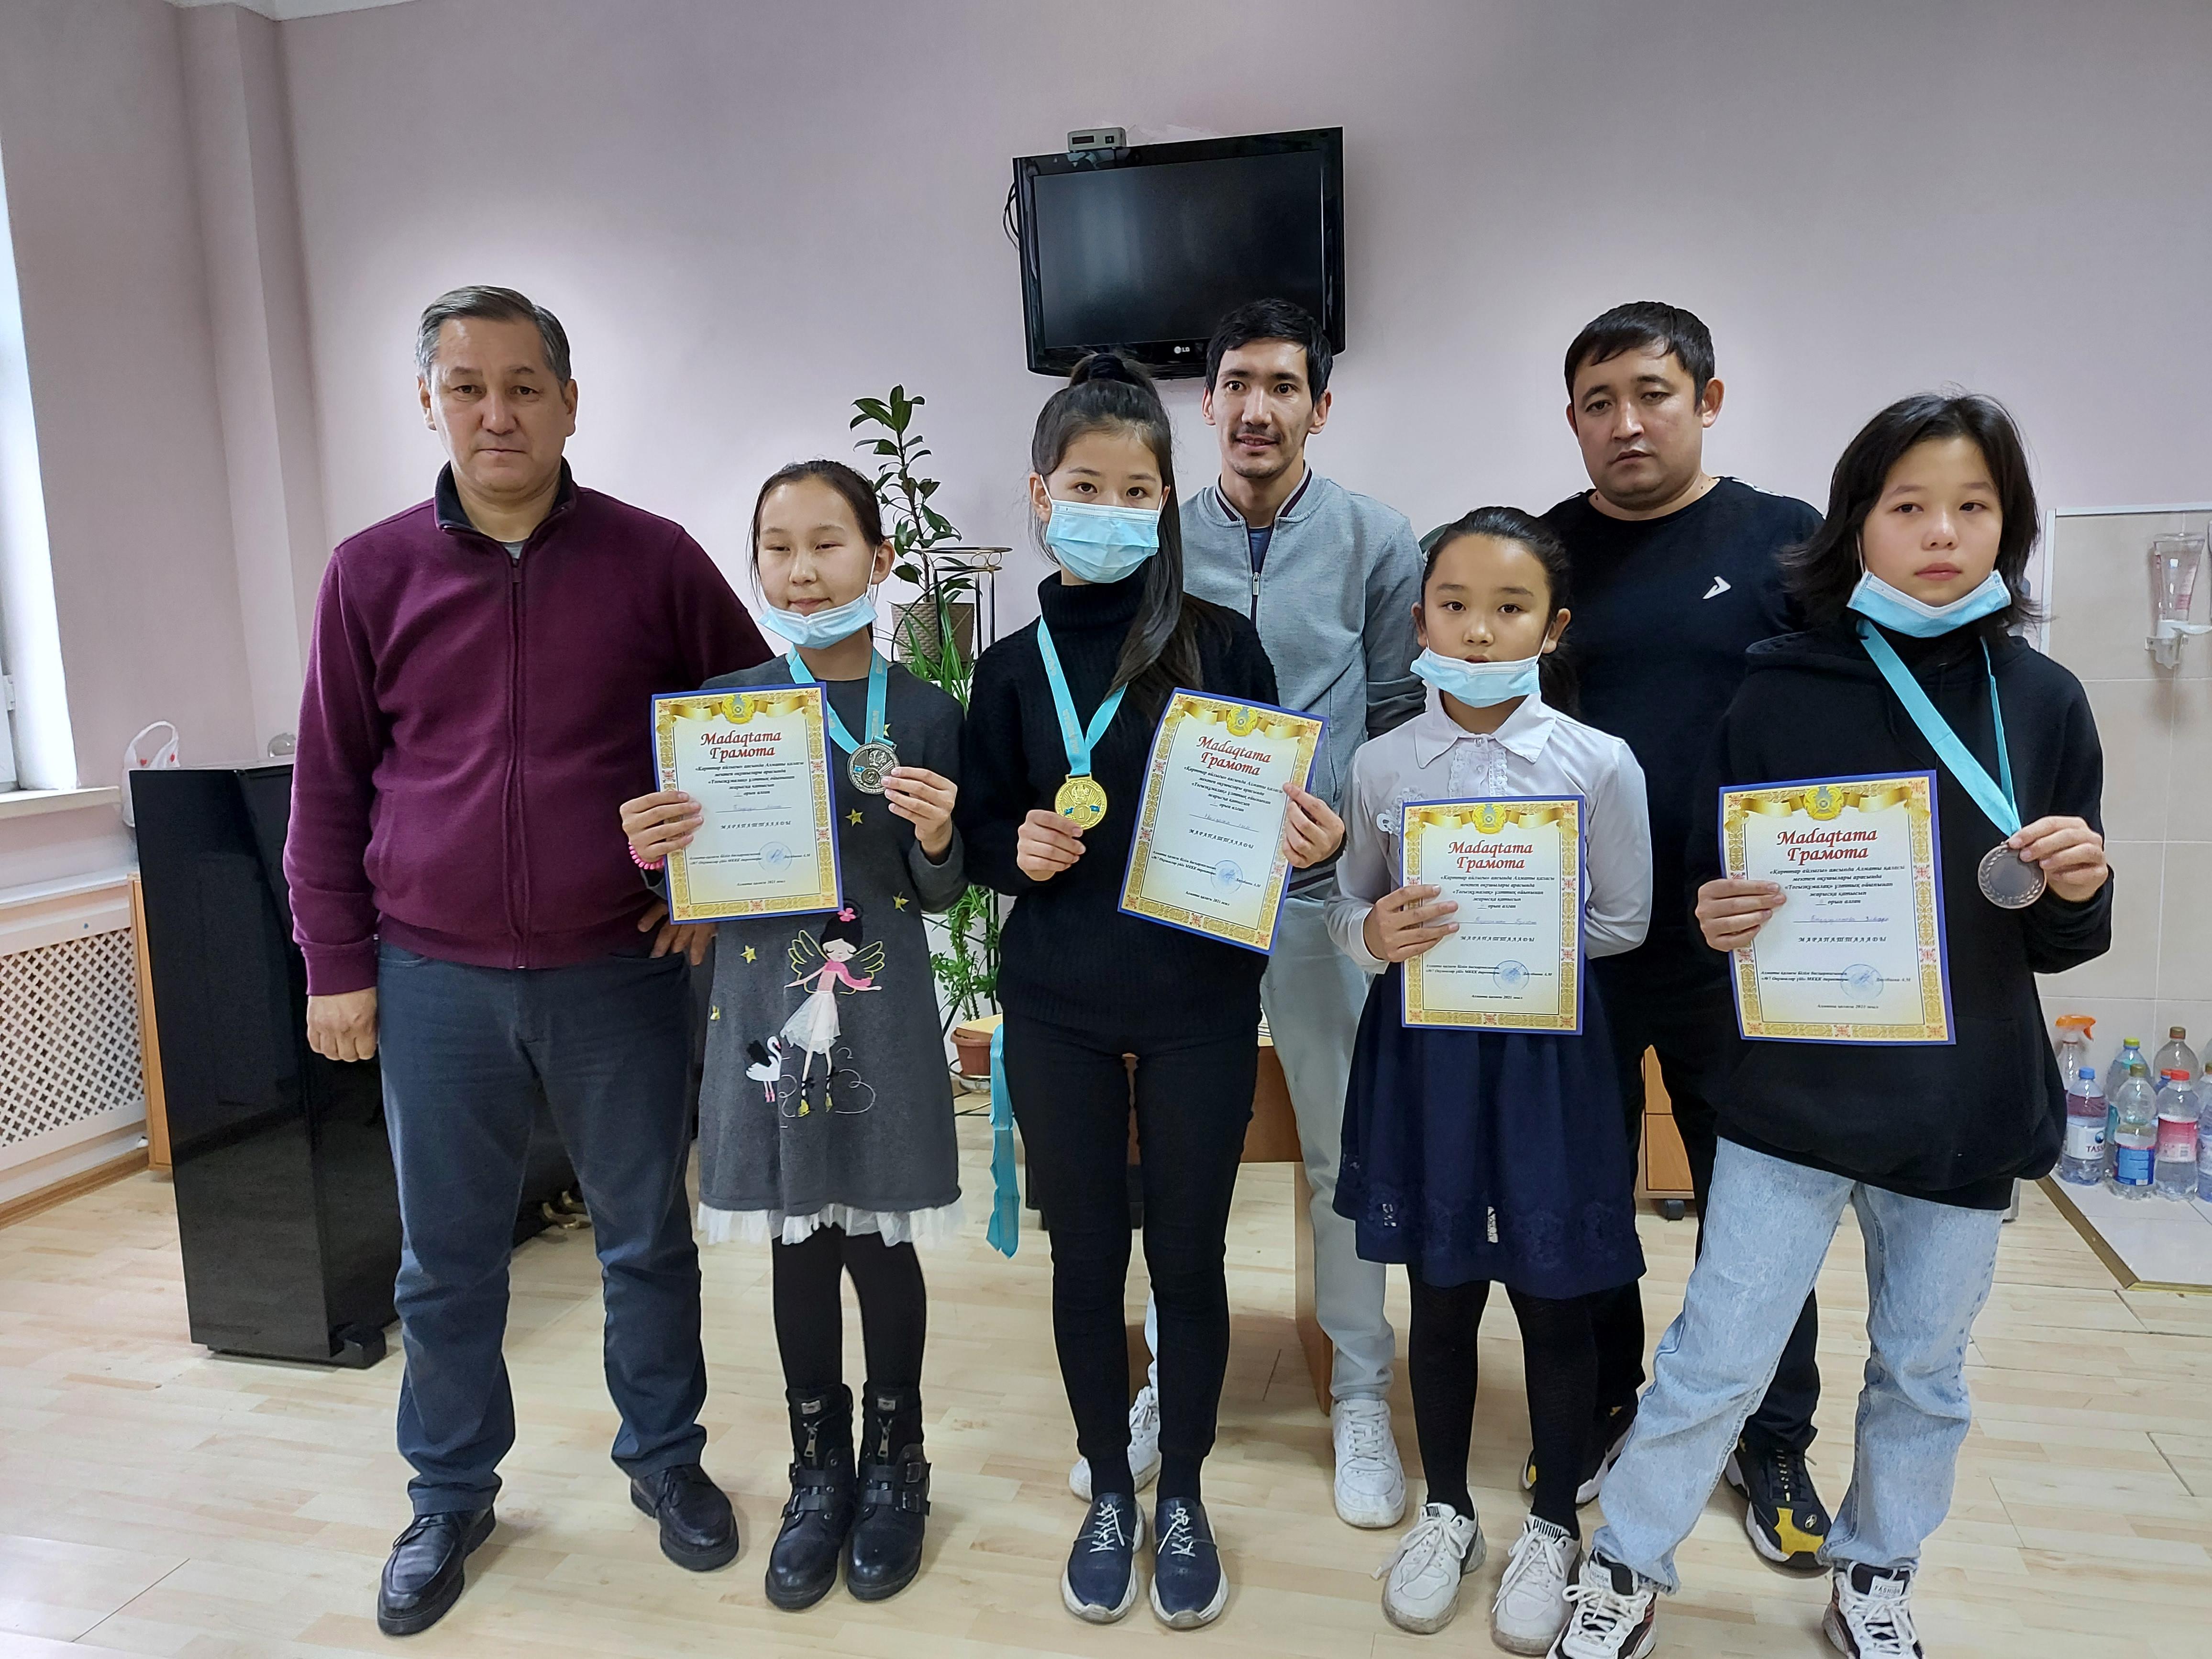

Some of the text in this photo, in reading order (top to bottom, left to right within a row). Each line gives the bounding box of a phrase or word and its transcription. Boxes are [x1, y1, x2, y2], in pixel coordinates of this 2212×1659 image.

[700, 730, 782, 747] Madaqtama
[710, 746, 775, 763] Грамота
[1196, 736, 1272, 763] Madaqtama
[1201, 752, 1260, 776] Грамота
[1776, 828, 1878, 847] Madaqtama
[1448, 840, 1533, 858] Madaqtama
[1787, 846, 1869, 865] Грамота
[1457, 857, 1525, 873] Грамота
